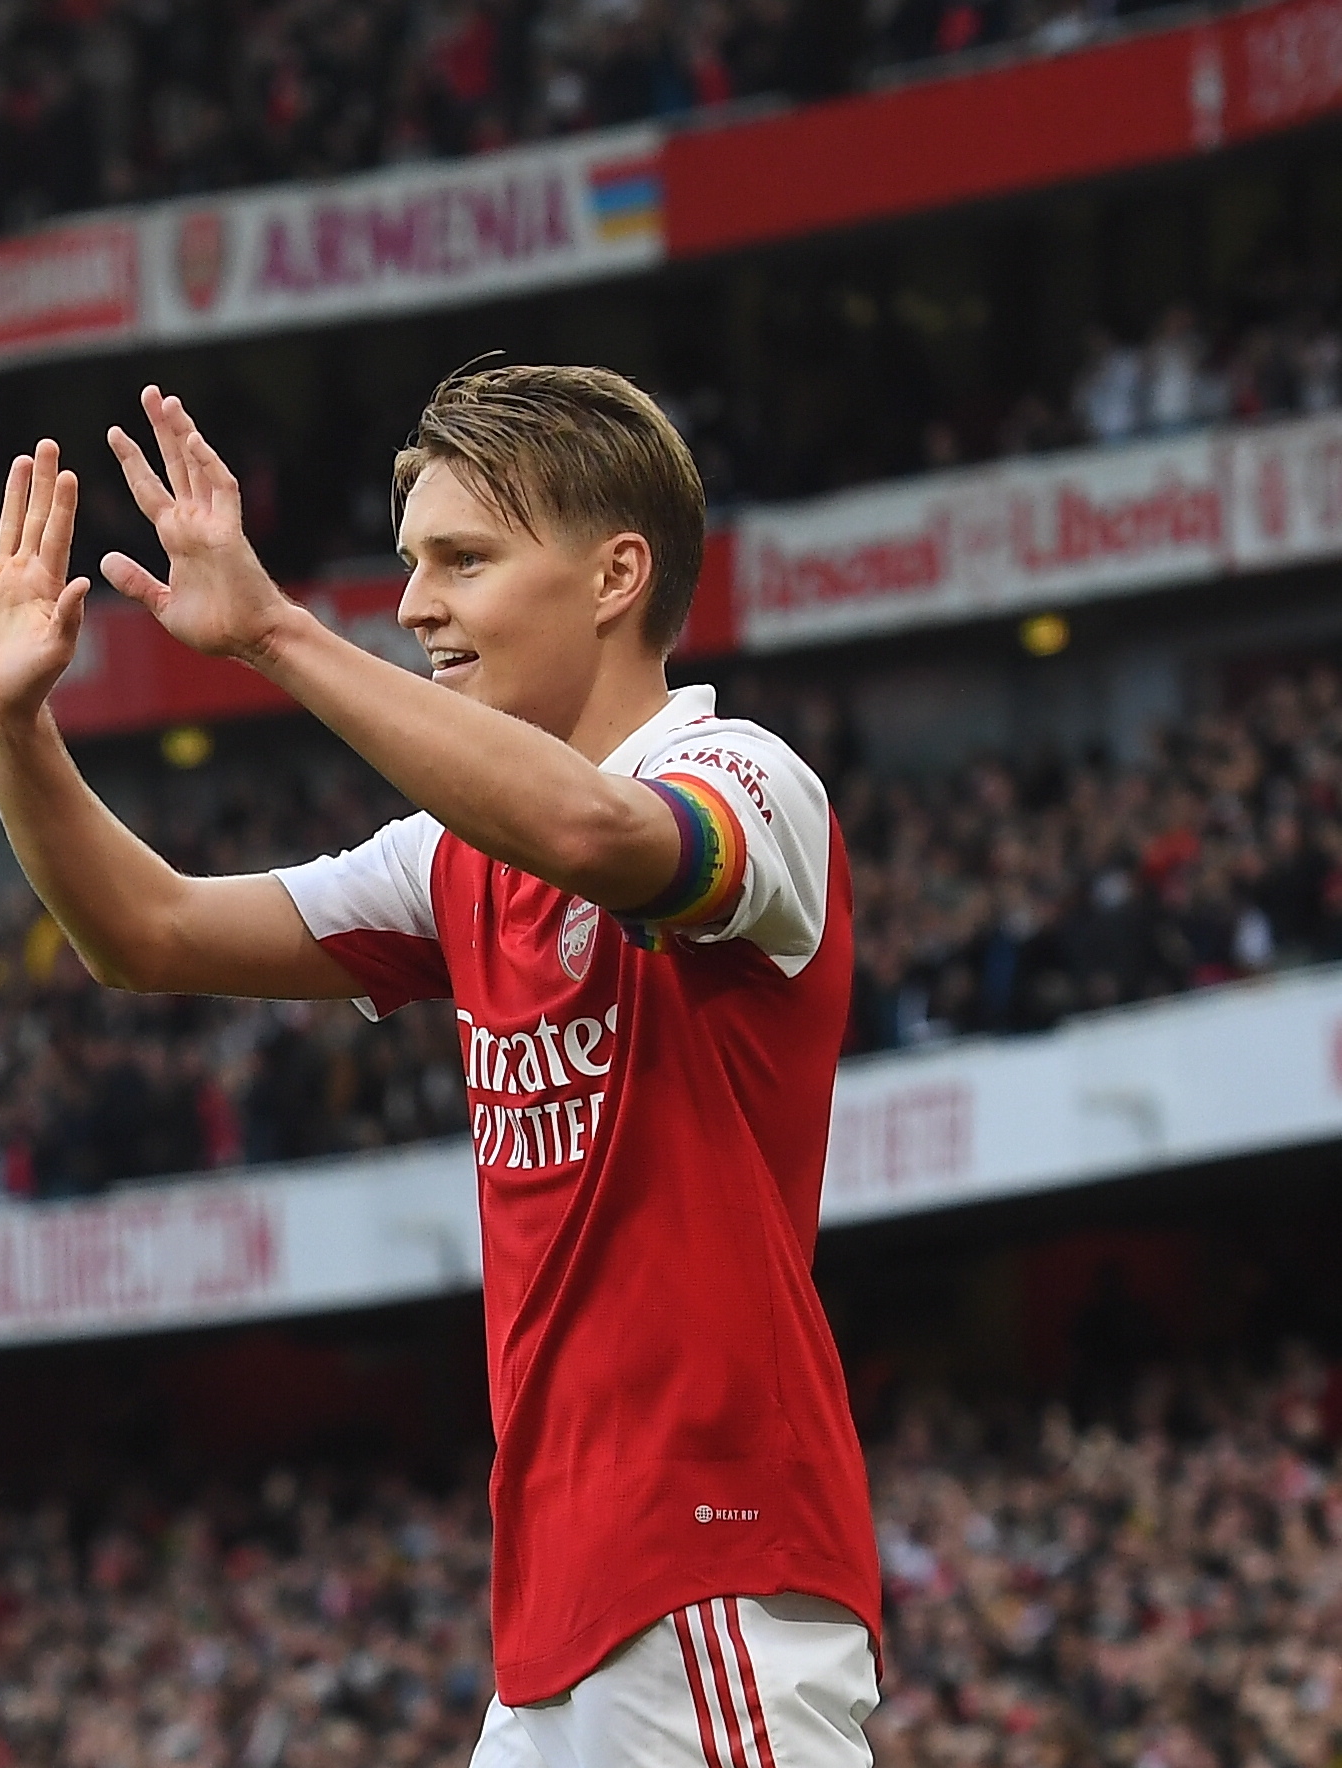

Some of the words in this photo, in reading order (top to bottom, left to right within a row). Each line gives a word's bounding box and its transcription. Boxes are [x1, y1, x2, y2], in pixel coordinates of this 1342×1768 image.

[258, 172, 574, 292] ARMENIA
[665, 751, 773, 825] WANDA
[715, 1508, 760, 1521] HEAT.RDY
